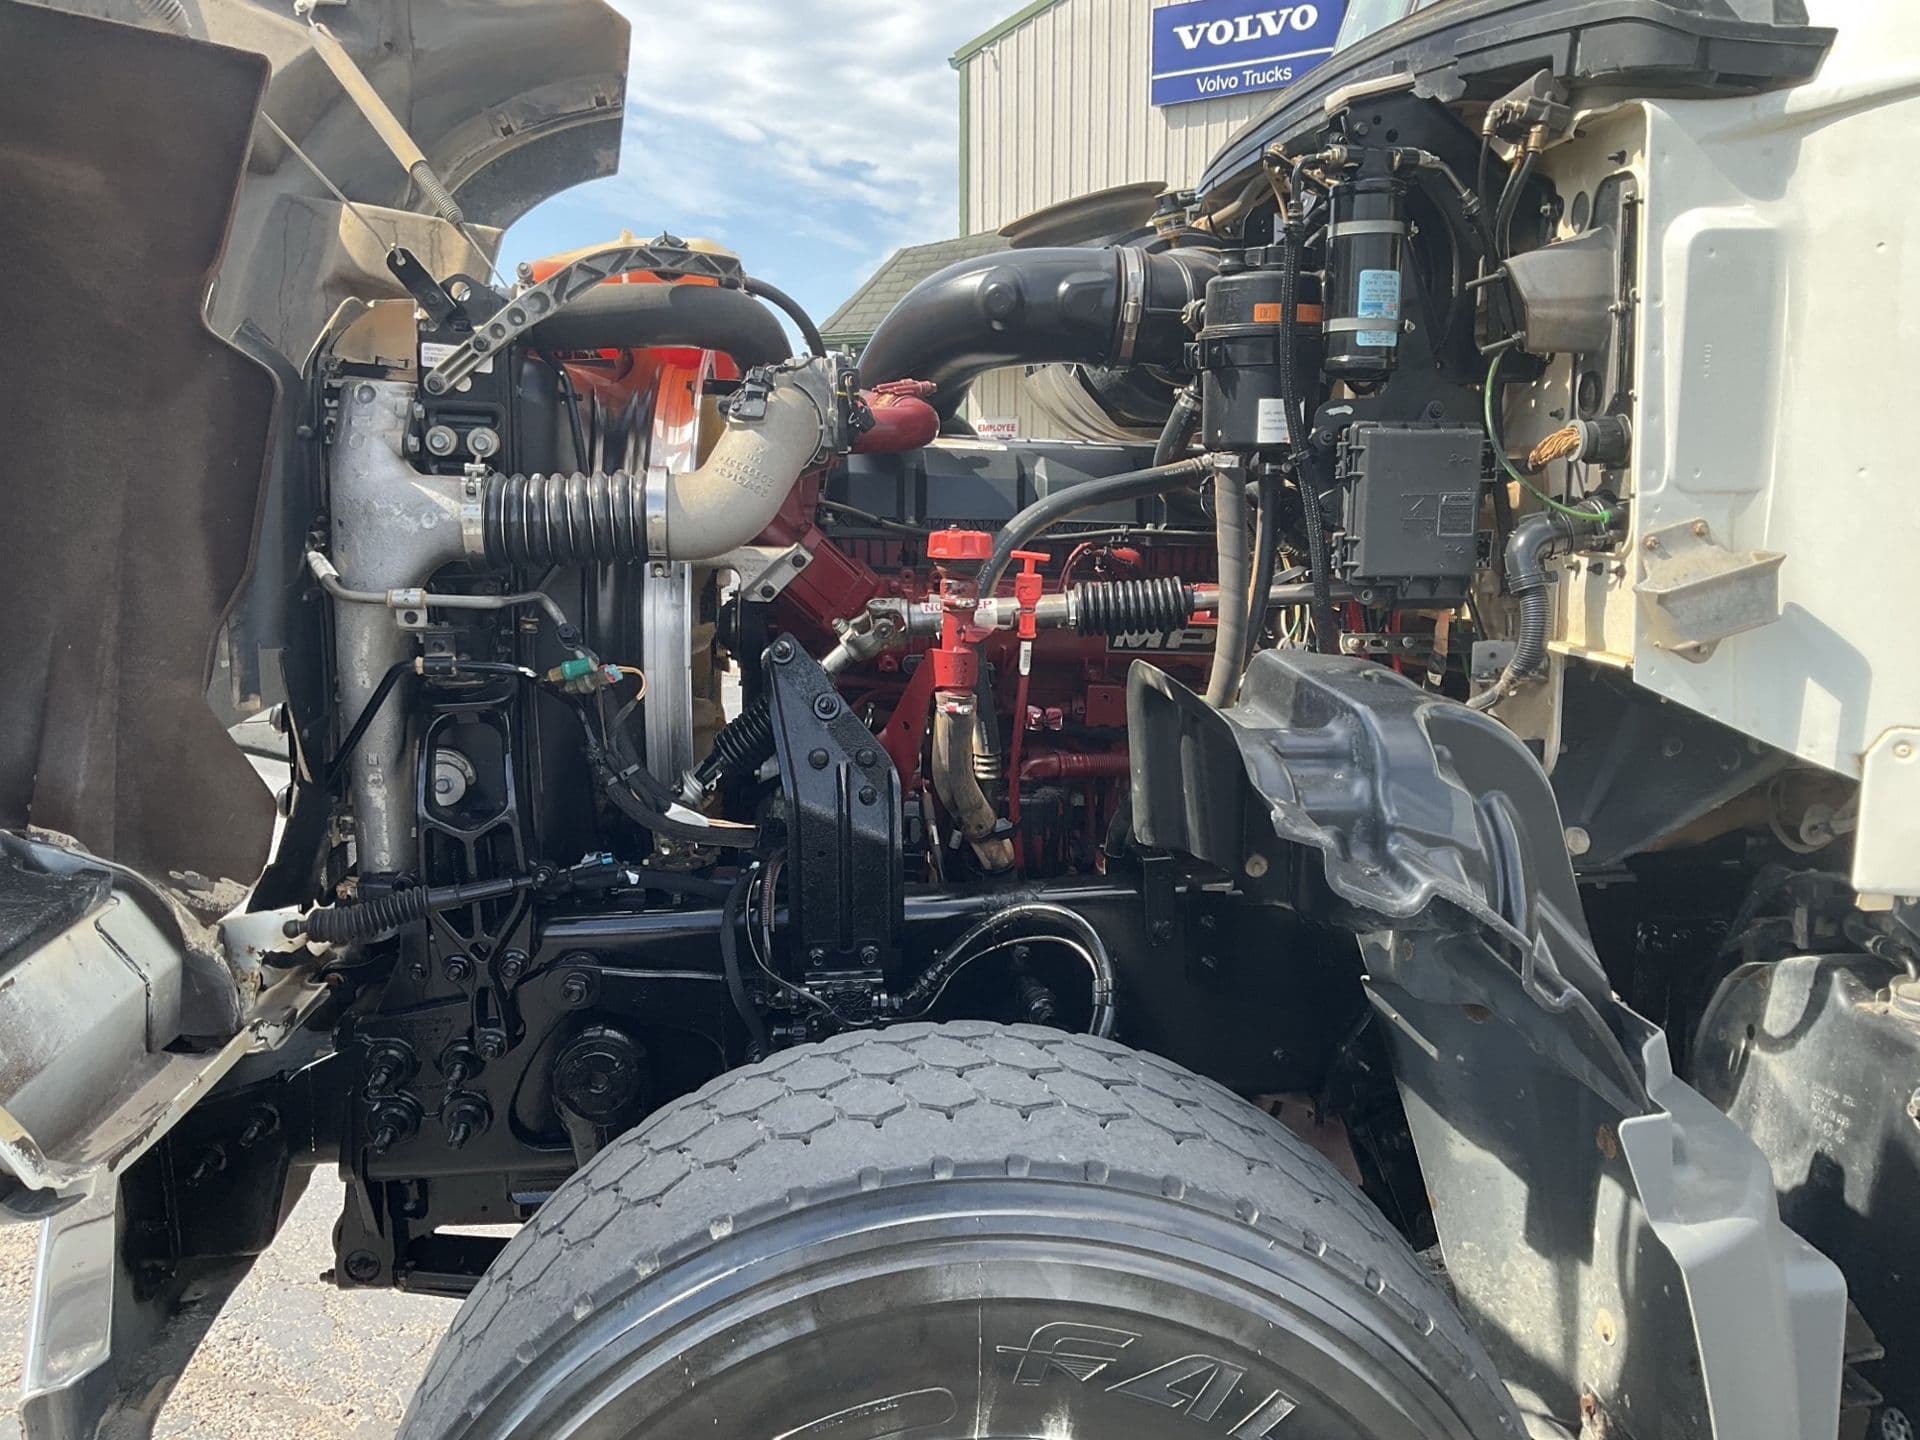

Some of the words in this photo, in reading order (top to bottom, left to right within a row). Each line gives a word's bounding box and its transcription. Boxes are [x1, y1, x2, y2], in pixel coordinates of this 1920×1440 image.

[1173, 4, 1318, 50] VOLVO
[1196, 74, 1239, 93] Volvo
[1242, 66, 1293, 87] Trucks
[977, 423, 1016, 432] EMPLOYEE
